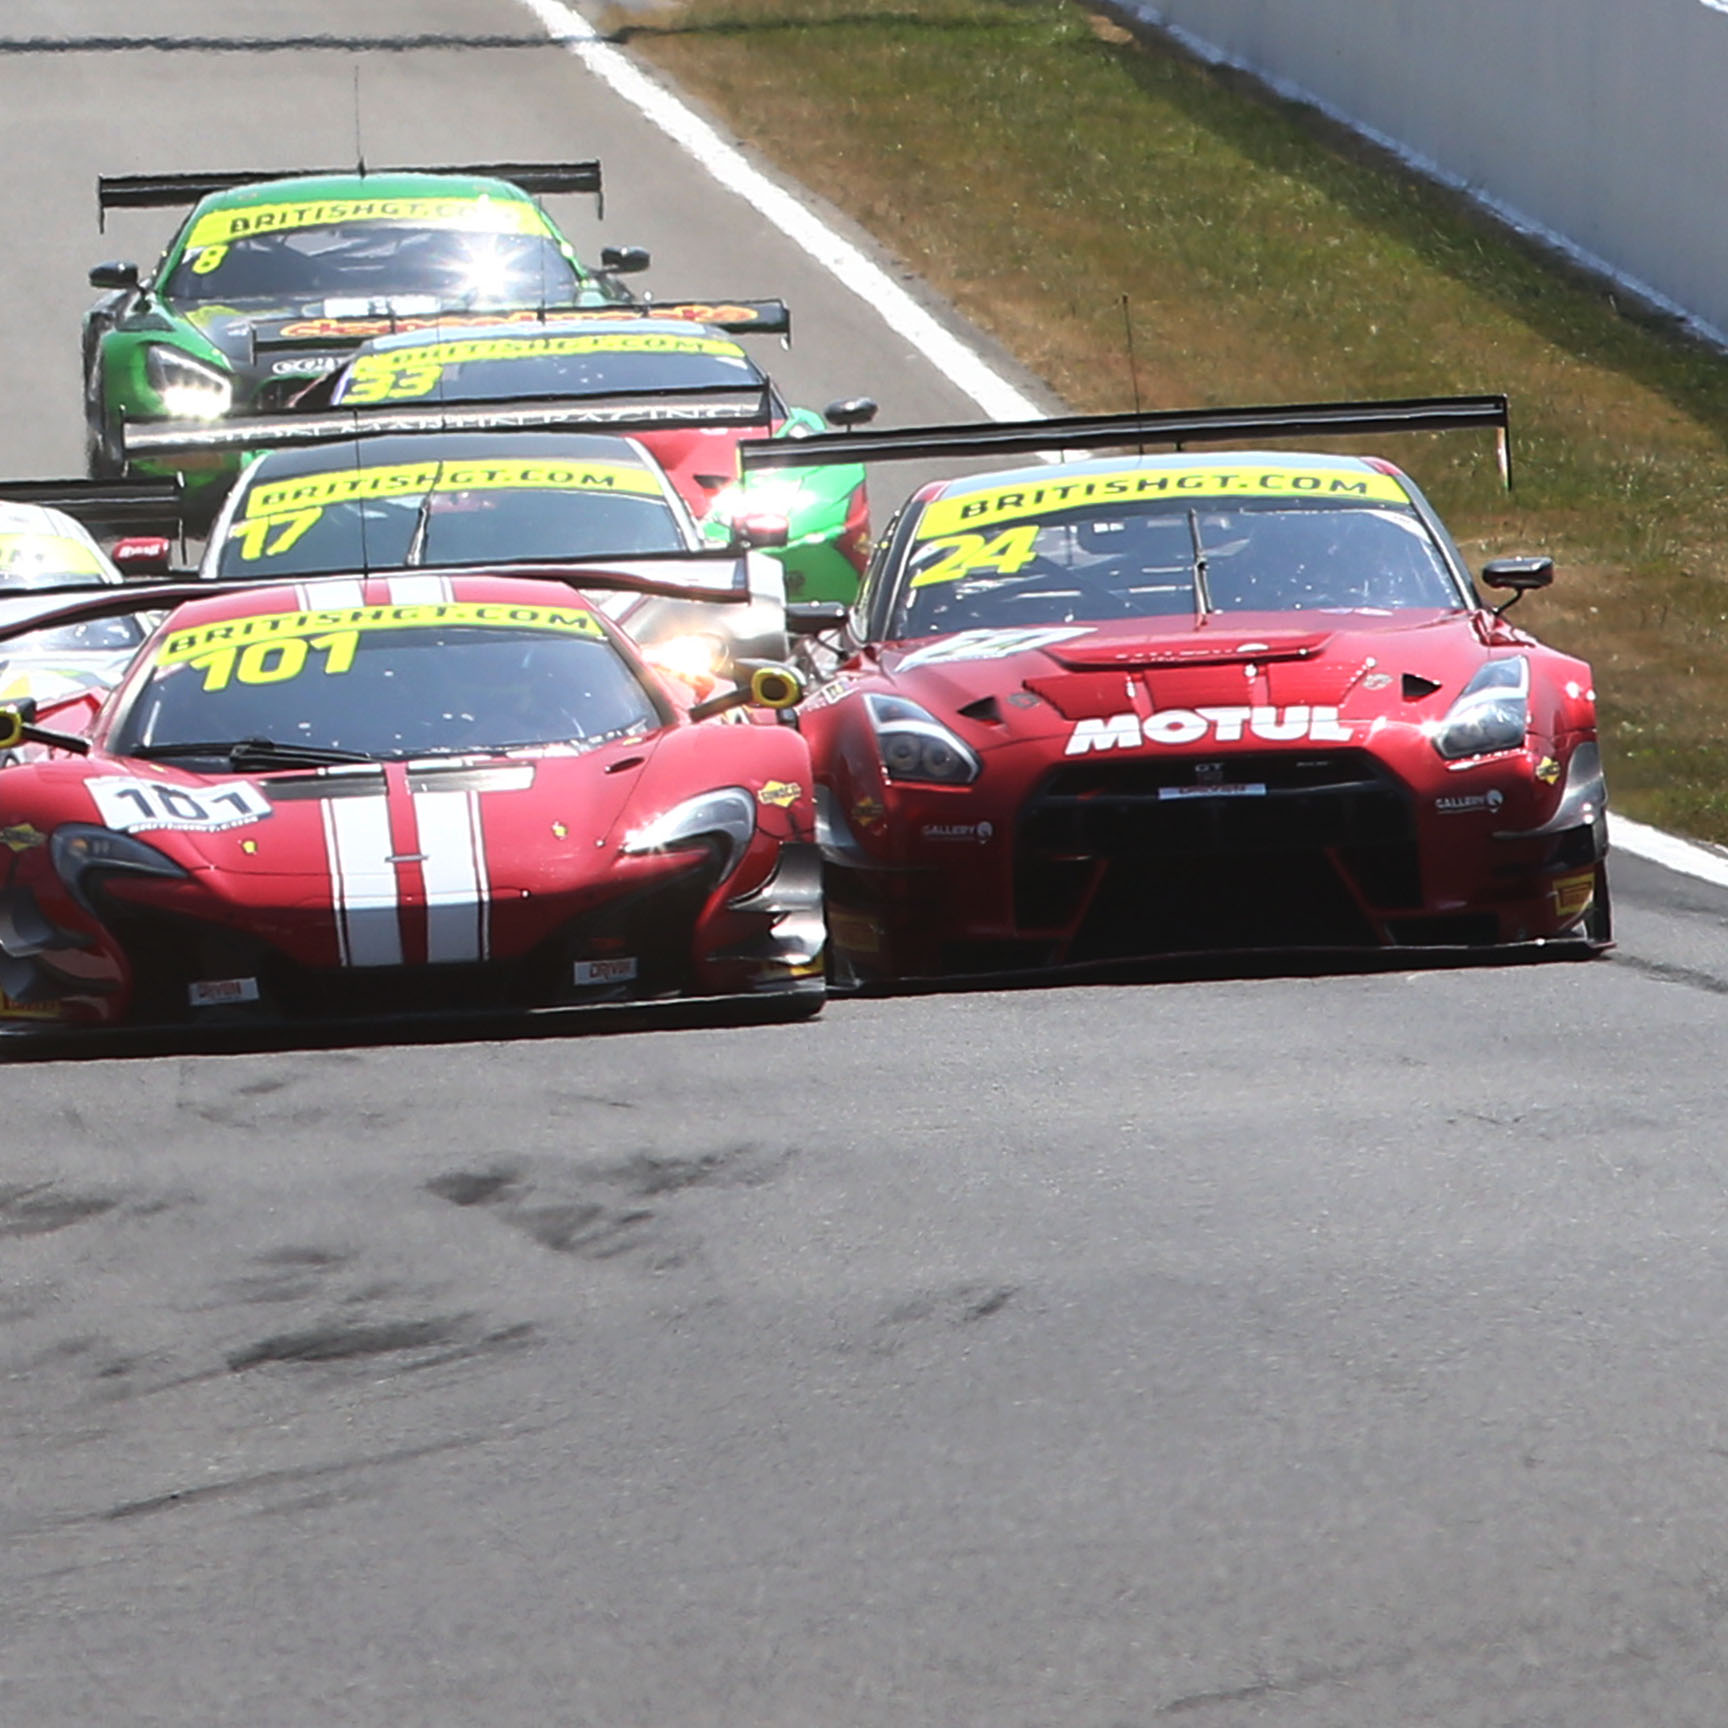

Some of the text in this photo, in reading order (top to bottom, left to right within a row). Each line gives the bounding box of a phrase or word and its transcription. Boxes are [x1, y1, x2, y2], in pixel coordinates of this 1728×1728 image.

[191, 244, 229, 275] 8
[344, 364, 442, 405] 33
[261, 468, 616, 508] BRITISHGT.COM
[960, 474, 1368, 520] BRITISHGT.COM
[229, 505, 323, 559] 17
[909, 525, 1041, 588] 24
[168, 604, 588, 655] BRITISHGT.COM
[190, 630, 361, 692] 101
[1064, 704, 1354, 756] MOTUL
[115, 784, 254, 820] 101
